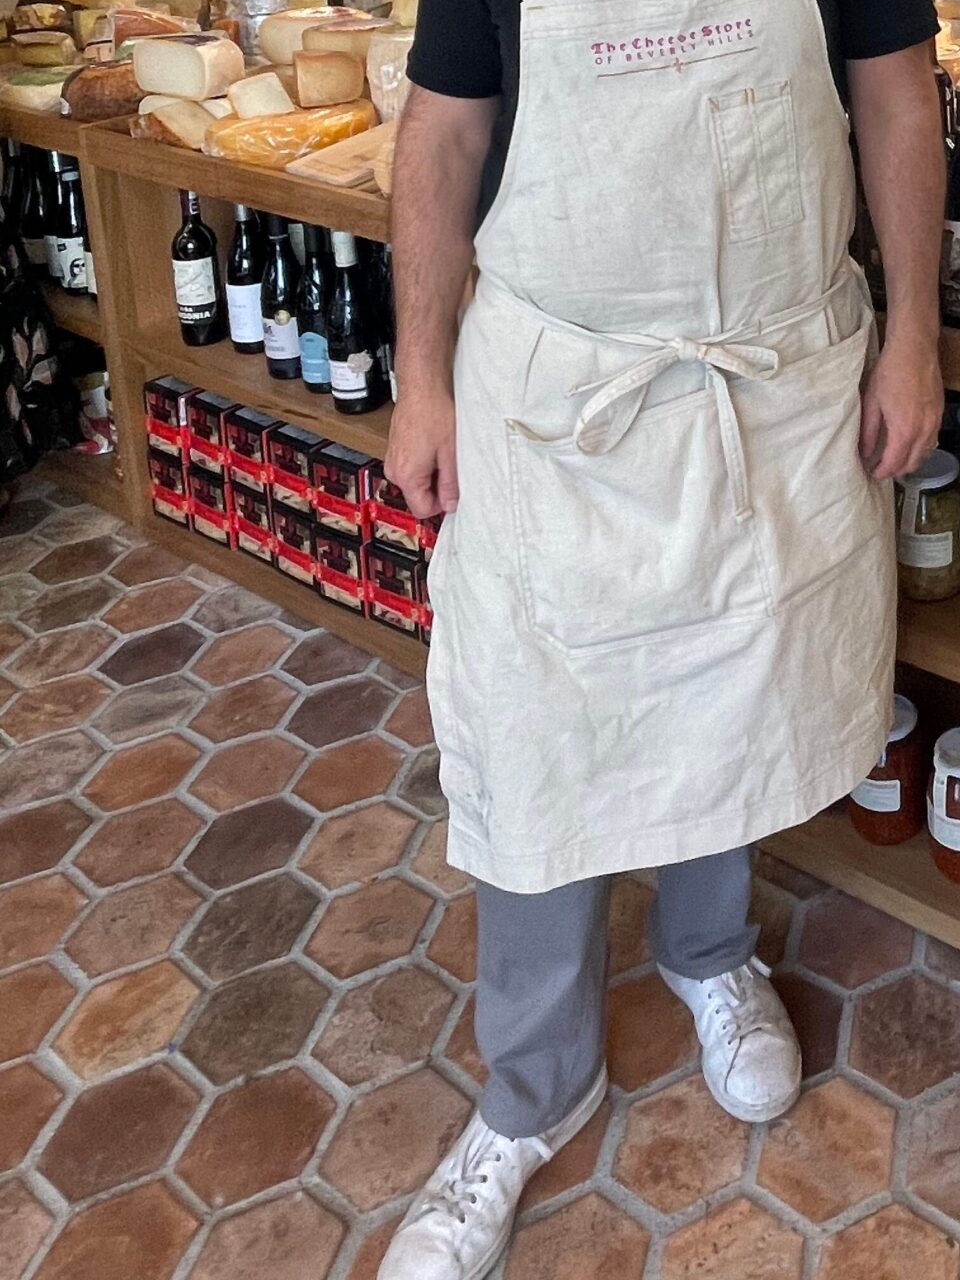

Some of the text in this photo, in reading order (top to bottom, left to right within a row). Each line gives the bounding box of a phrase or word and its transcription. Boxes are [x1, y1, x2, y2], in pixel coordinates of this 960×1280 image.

[590, 18, 752, 55] The Cheese Store
[594, 29, 755, 66] OF BEVERLY HILLS
